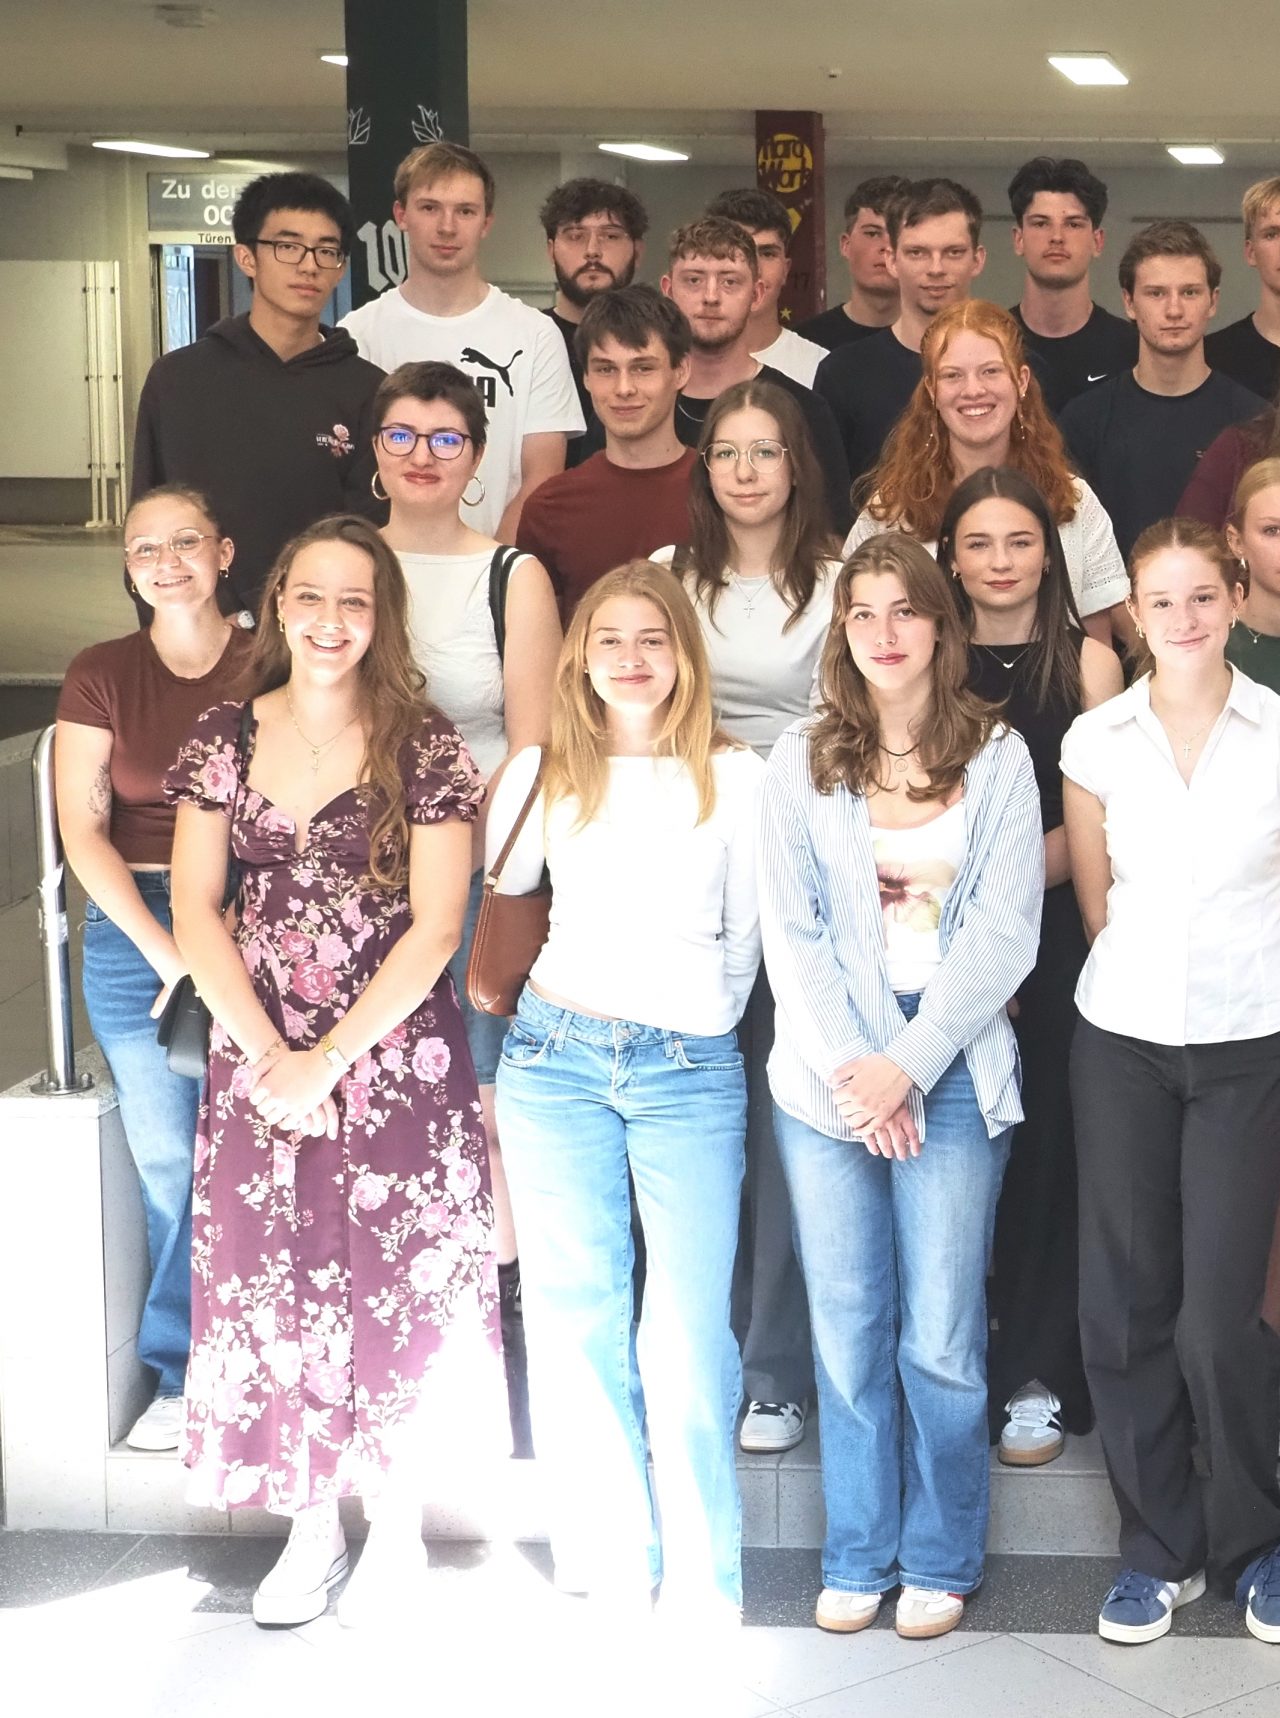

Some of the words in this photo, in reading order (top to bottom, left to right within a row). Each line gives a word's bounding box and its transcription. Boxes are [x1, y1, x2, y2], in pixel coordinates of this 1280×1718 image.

[161, 179, 191, 199] Zu
[197, 233, 232, 244] Türen
[356, 219, 410, 292] 10
